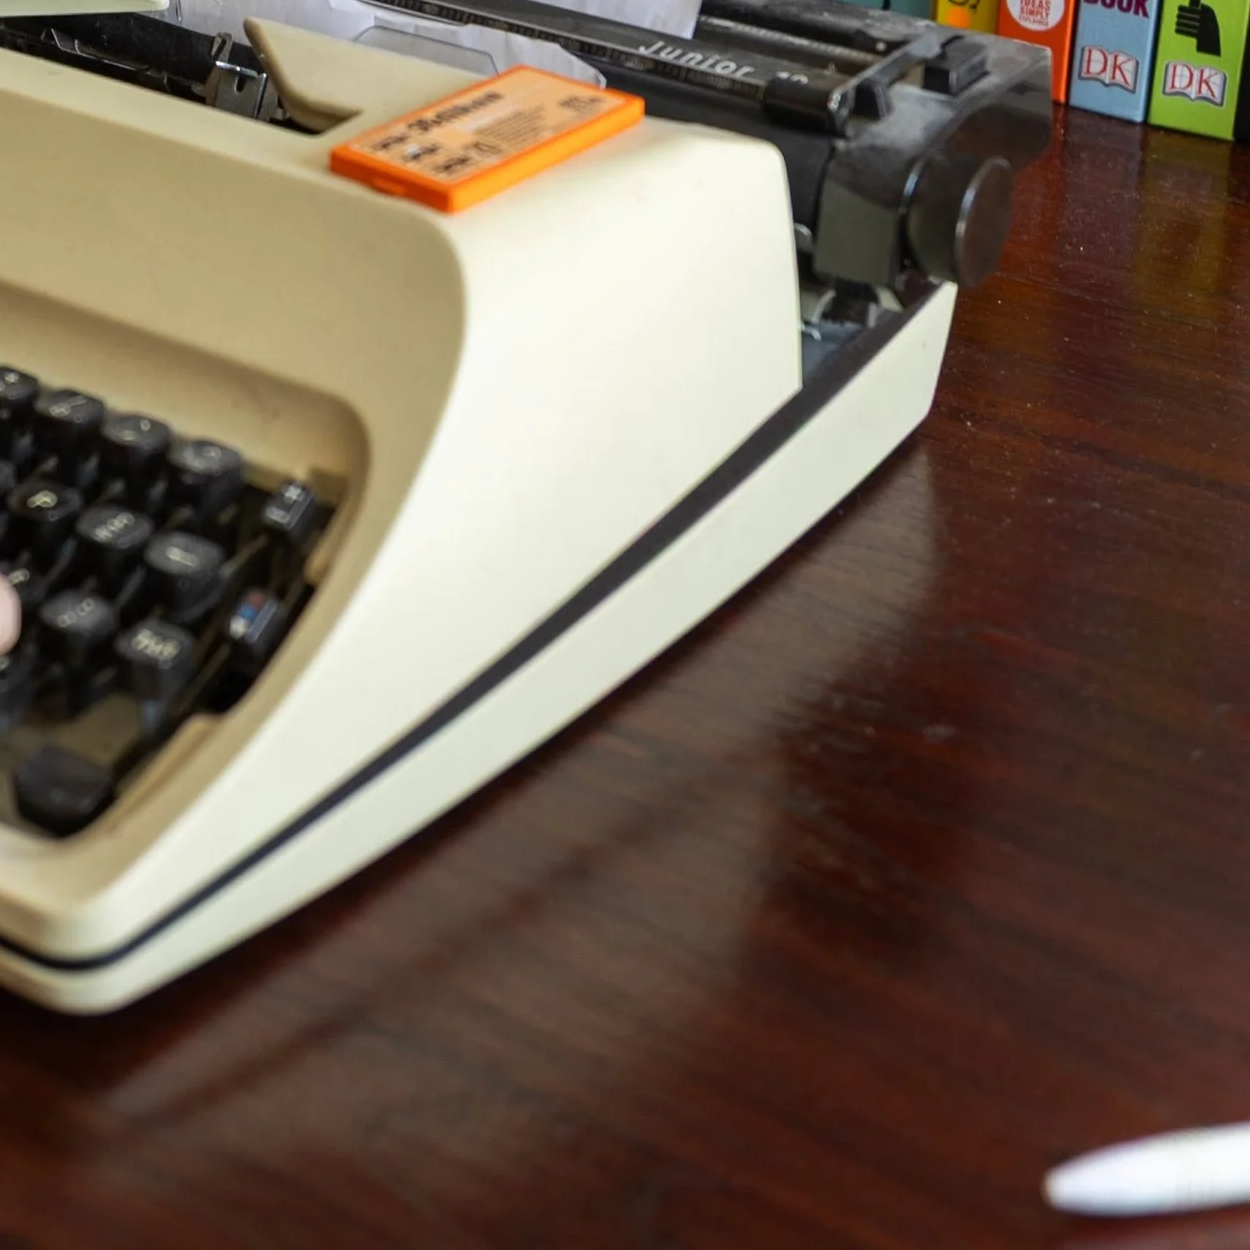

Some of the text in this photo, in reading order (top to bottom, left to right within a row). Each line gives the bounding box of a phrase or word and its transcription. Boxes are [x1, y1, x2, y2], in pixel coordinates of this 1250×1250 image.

[638, 40, 755, 78] Junior
[1083, 46, 1133, 87] DK
[1169, 62, 1220, 101] DK
